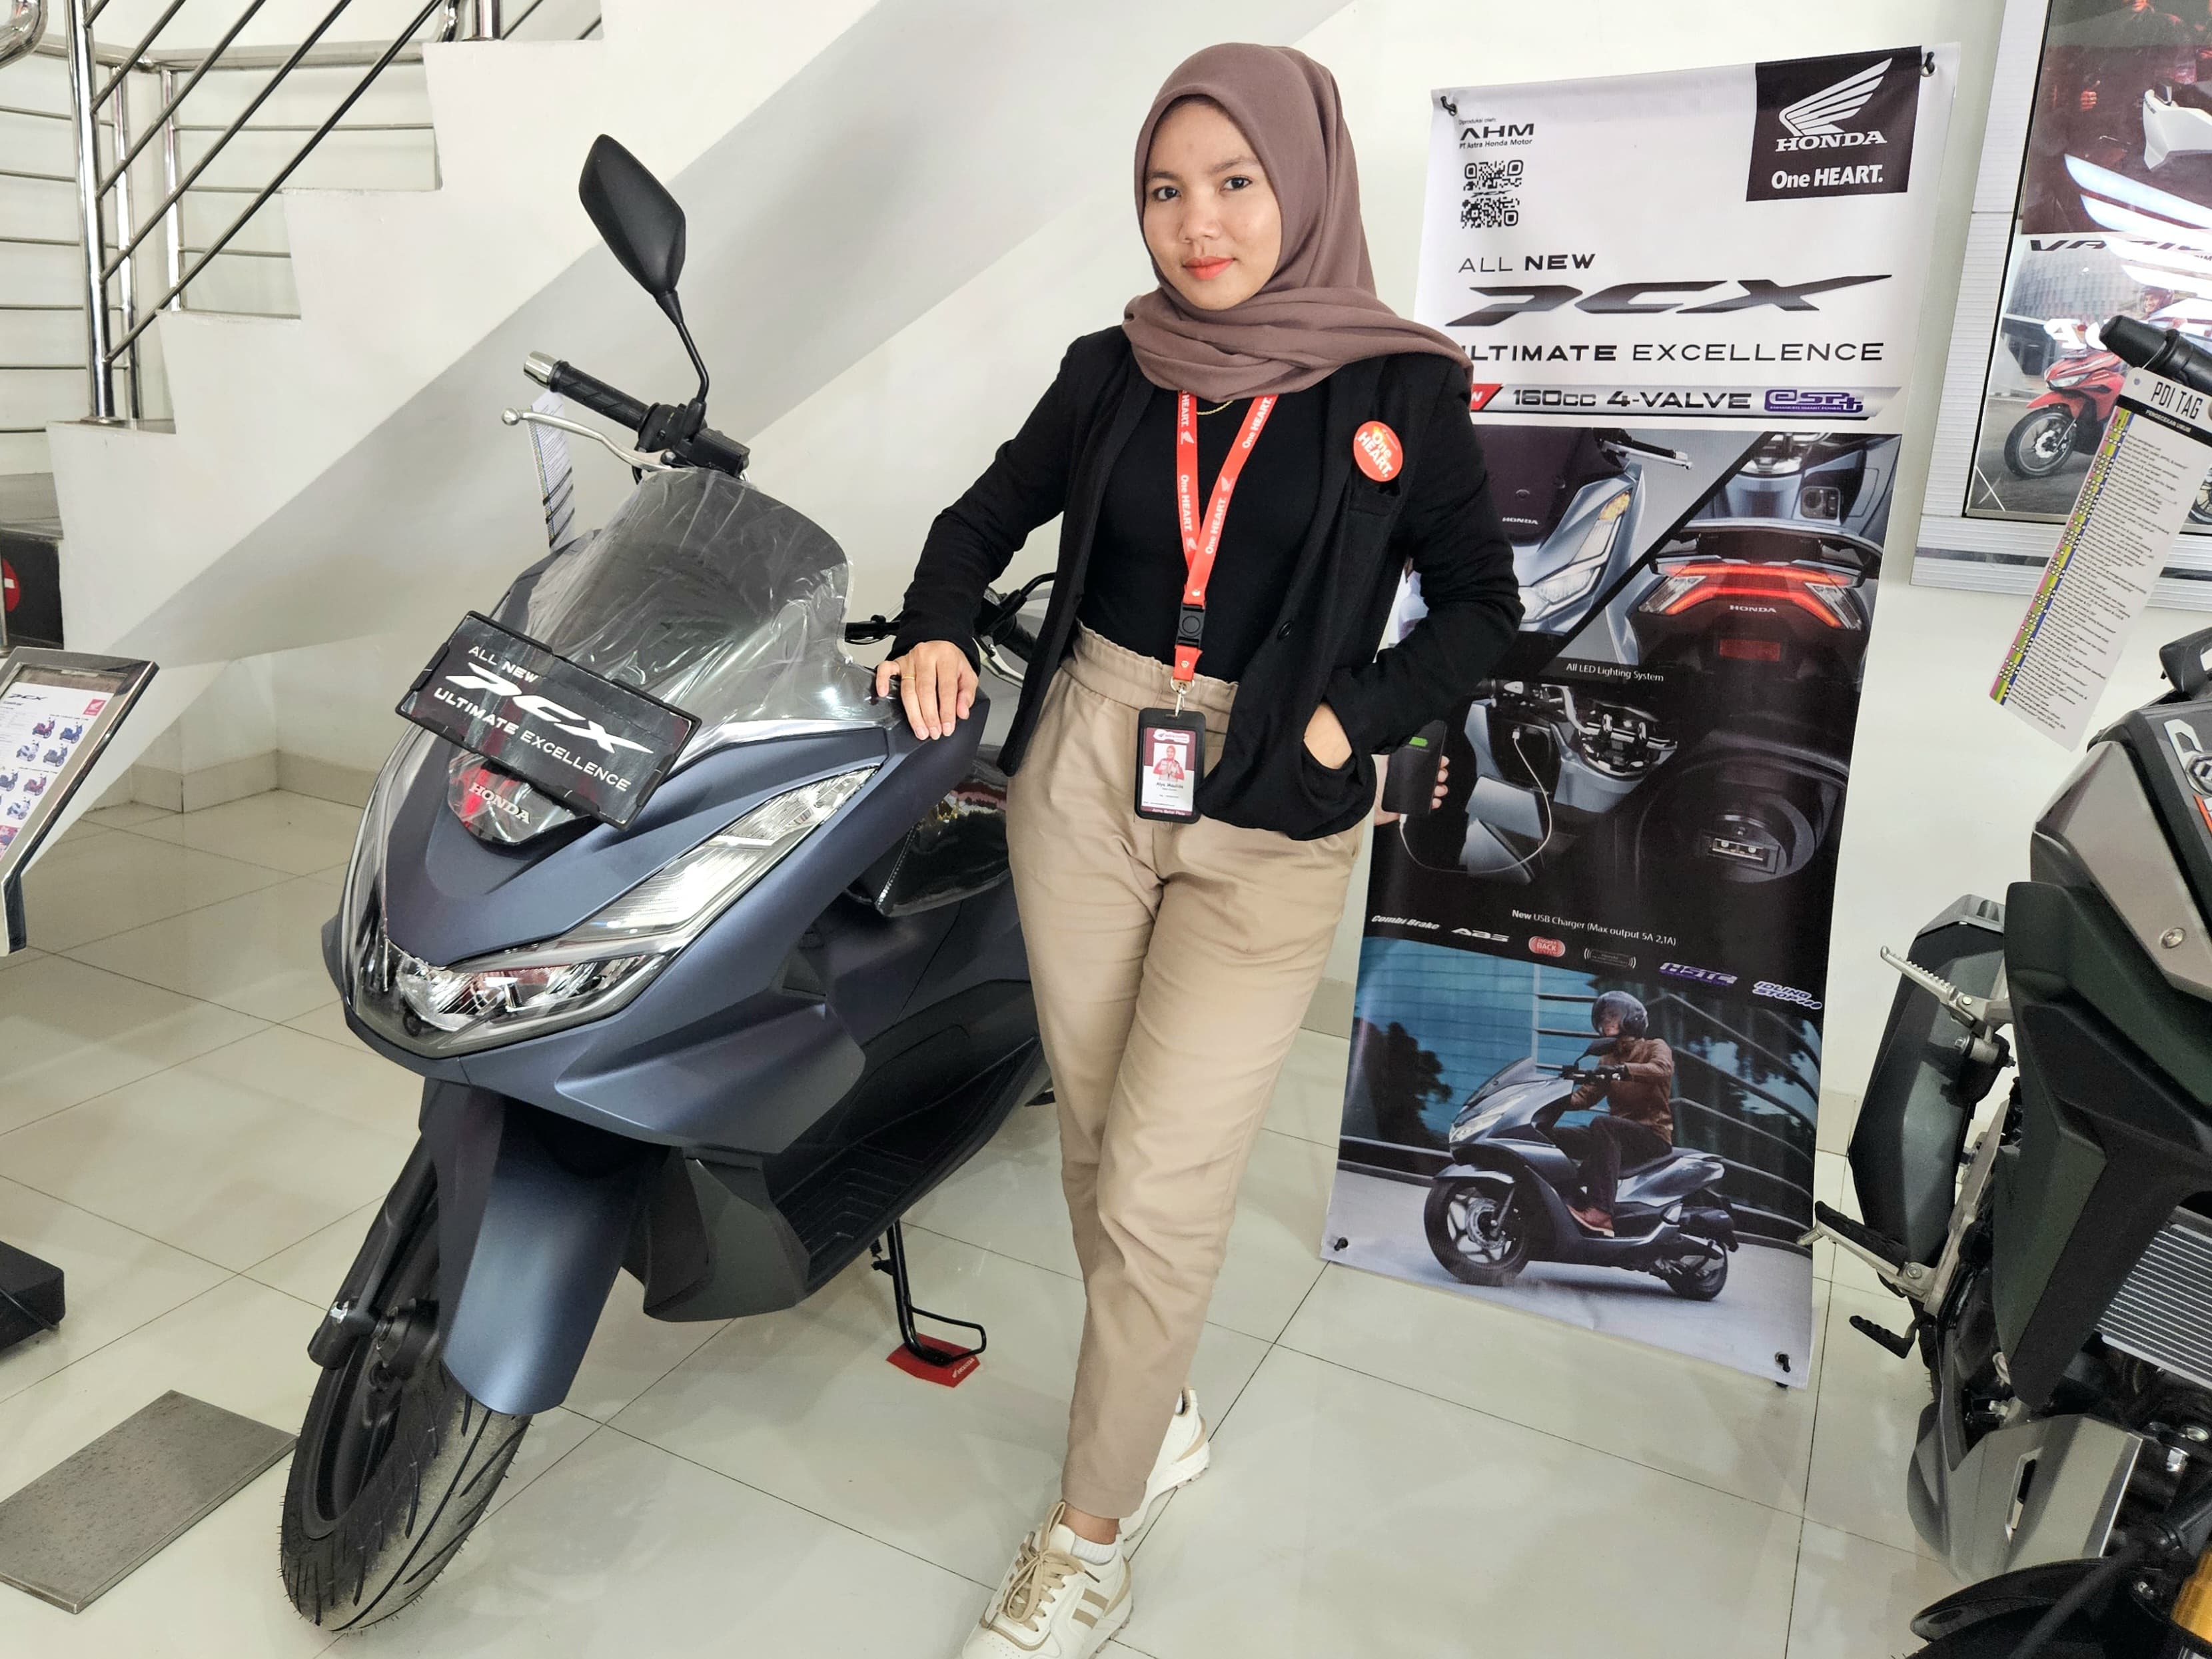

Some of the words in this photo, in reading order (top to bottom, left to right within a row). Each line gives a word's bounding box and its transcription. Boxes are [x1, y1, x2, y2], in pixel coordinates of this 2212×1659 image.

[1460, 123, 1534, 141] AHM
[1775, 130, 1888, 152] HONDA
[1771, 169, 1810, 189] One
[1814, 163, 1884, 187] HEART.
[1458, 257, 1514, 273] ALL
[1524, 253, 1596, 271] NEW
[1445, 275, 1892, 327] PCX
[1462, 345, 1617, 361] LTIMATE
[1632, 342, 1884, 361] EXCELLENCE
[1512, 389, 1596, 406] 160cc
[1606, 390, 1752, 409] 4-VALVE
[2150, 382, 2176, 409] PDI
[2175, 390, 2203, 420] TAG
[1241, 431, 1255, 449] One
[1372, 431, 1392, 458] One
[1181, 474, 1189, 493] One
[1502, 516, 1538, 526] HONDA
[1205, 534, 1217, 554] One
[1729, 604, 1777, 614] HONDA
[468, 645, 496, 664] ALL
[502, 661, 538, 683] NEW
[1566, 662, 1577, 672] All
[1579, 665, 1596, 674] LED
[1597, 666, 1632, 680] Lighting
[1633, 670, 1664, 682] System
[446, 662, 654, 754] PCX
[434, 688, 518, 736] ULTIMATE
[520, 730, 631, 792] EXCELLENCE
[469, 783, 531, 825] HONDA
[1371, 915, 1406, 925] Combi
[1406, 918, 1440, 930] Brake
[1512, 909, 1532, 920] New
[1533, 913, 1550, 923] USB
[1552, 915, 1586, 931] Charger
[1587, 921, 1608, 934] (Max
[1610, 927, 1639, 940] output
[1450, 927, 1510, 943] ABS
[1536, 943, 1557, 951] BACK
[1754, 989, 1798, 1001] STOP
[1756, 982, 1811, 999] IDLING
